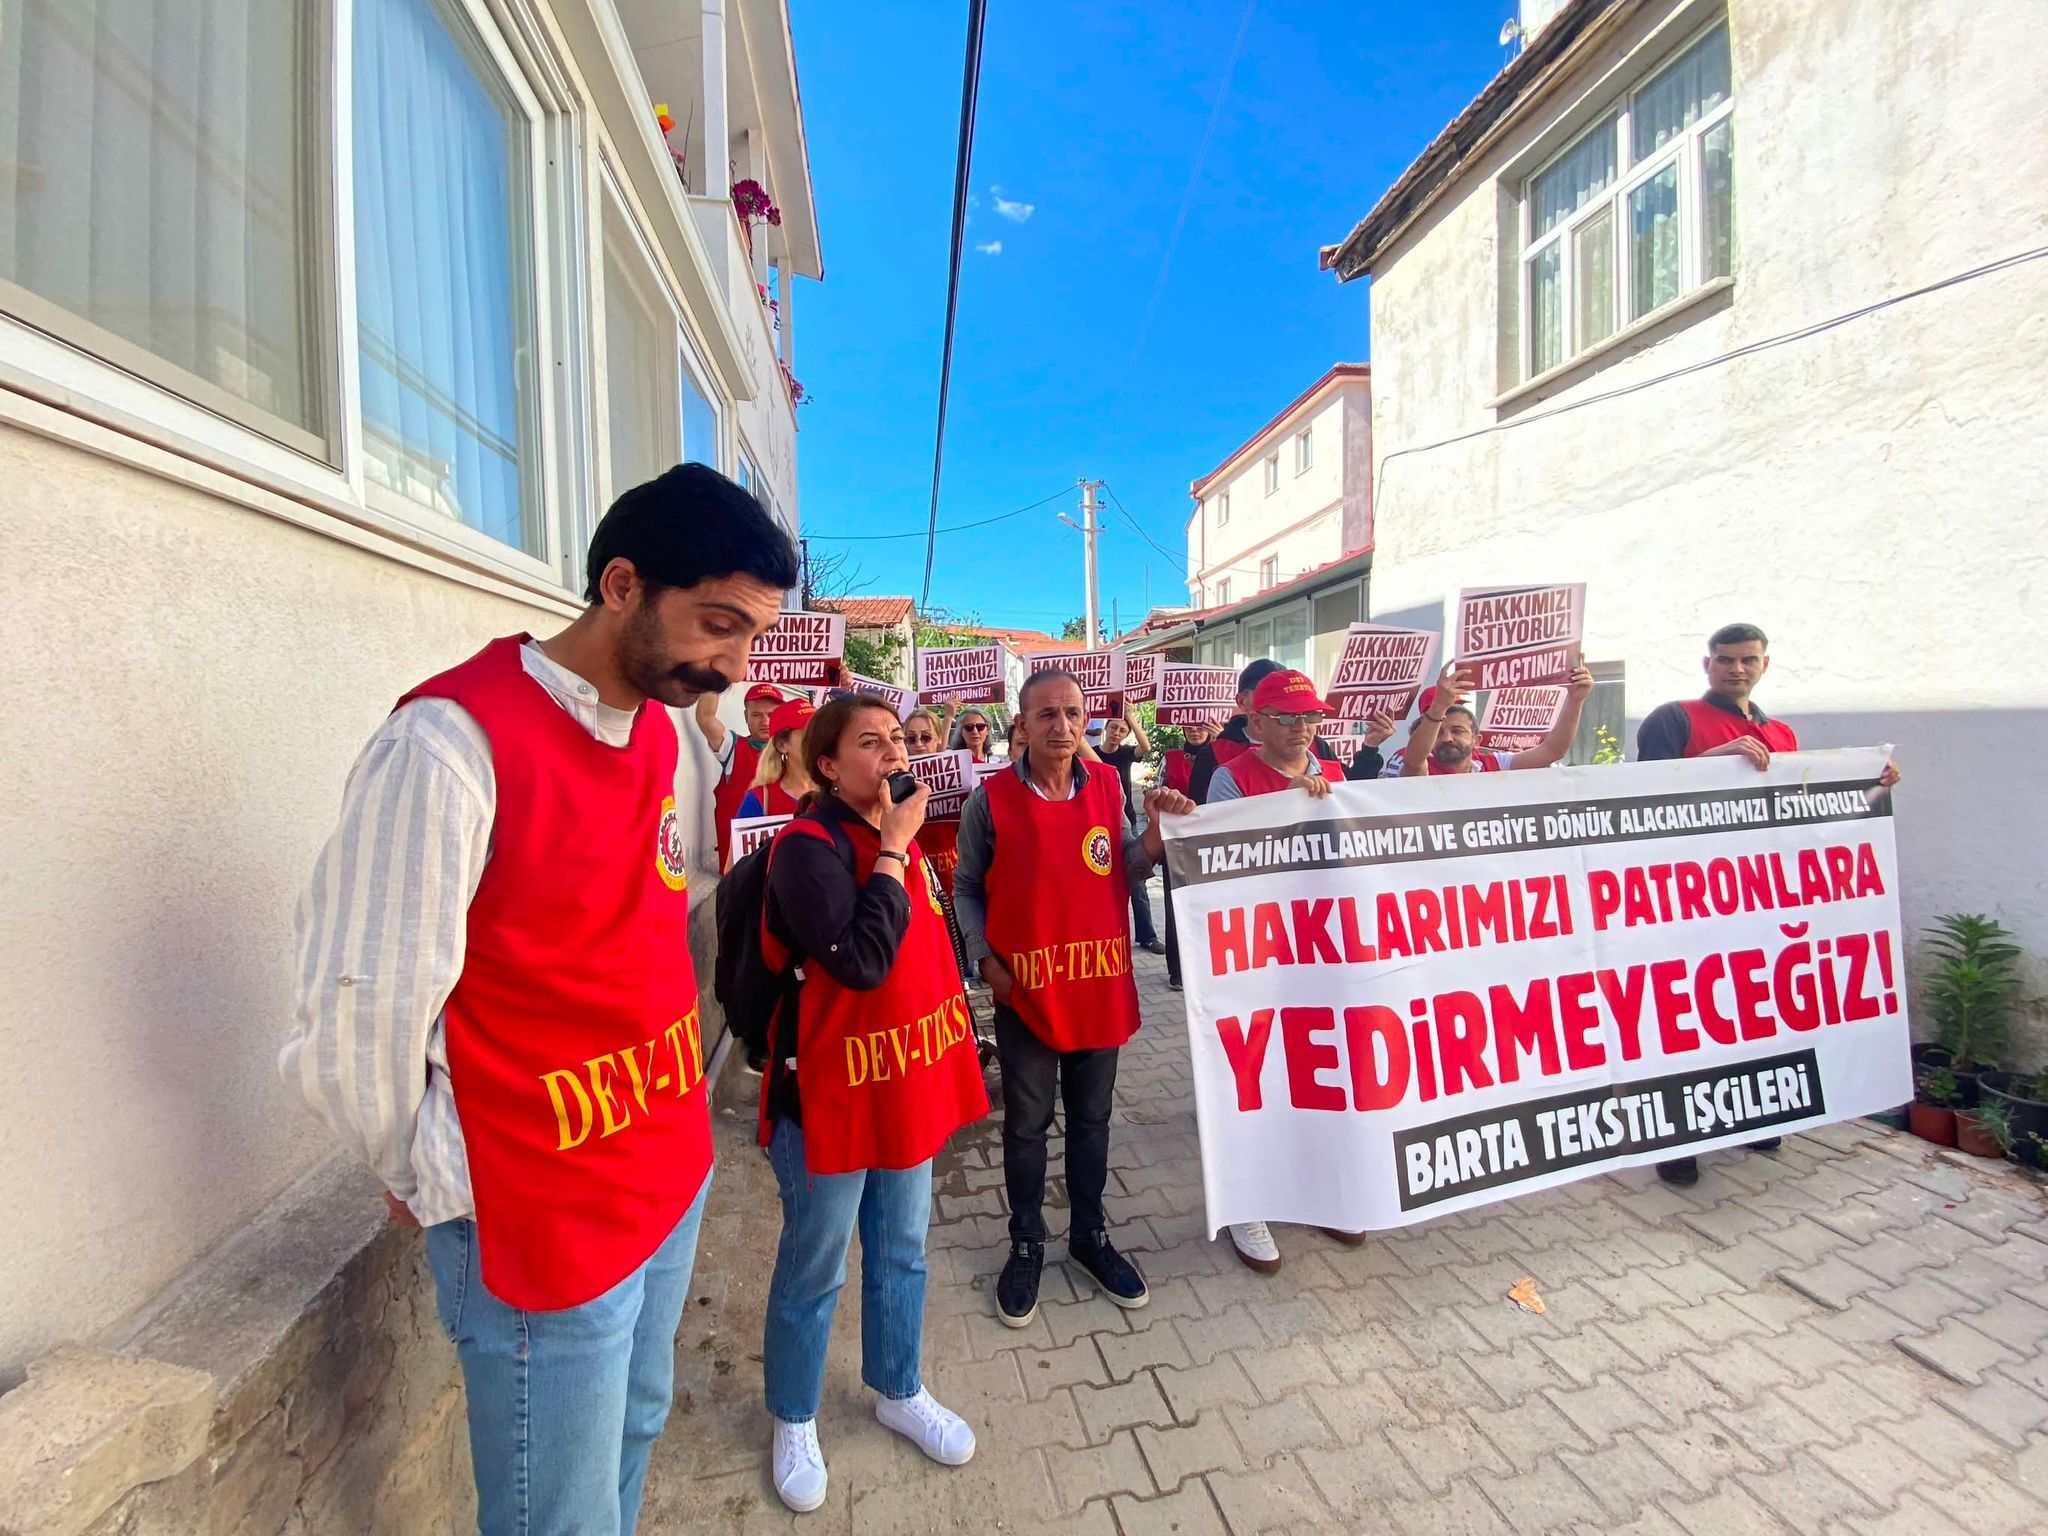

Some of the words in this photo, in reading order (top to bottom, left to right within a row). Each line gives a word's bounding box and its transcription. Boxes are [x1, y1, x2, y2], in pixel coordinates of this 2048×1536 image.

[1465, 588, 1572, 626] HAKKIMIZI
[1464, 612, 1571, 652] İSTİYORUZ!
[925, 648, 998, 671] HAKKIMIZI
[1344, 636, 1429, 659] HAKKIMIZI
[746, 661, 825, 683] KAÇTINIZ!
[925, 663, 998, 687] İSTİYORUZ!
[1163, 671, 1238, 686] HAKKIMIZI
[1336, 658, 1423, 683] İSTİYORUZ!
[1482, 650, 1567, 688] KAÇTINIZ!
[1163, 686, 1237, 702] İSTİYORUZ!
[1496, 688, 1561, 707] HAKKIMIZI
[1489, 706, 1555, 726] İSTİYORUZ!
[1197, 825, 1424, 875] TAZMİNATLARIMIZI
[1428, 823, 1456, 851] VE
[1462, 813, 1538, 849] GERİYE
[1544, 806, 1615, 842] DÖNÜK
[1620, 797, 1769, 835] ALACAKLARIMIZI
[1773, 789, 1872, 821] İSTİYORUZ!
[1207, 874, 1574, 976] HAKLARIMIZI
[1587, 842, 1886, 931] PATRONLARA
[1012, 928, 1130, 990] DEV-TEKSİL
[1216, 921, 1899, 1112] YEDİRMEYECEĞİZ!
[1405, 1118, 1530, 1196] BARTA
[1536, 1088, 1675, 1161] TEKSTİL
[1683, 1063, 1812, 1134] İŞÇİLERİ
